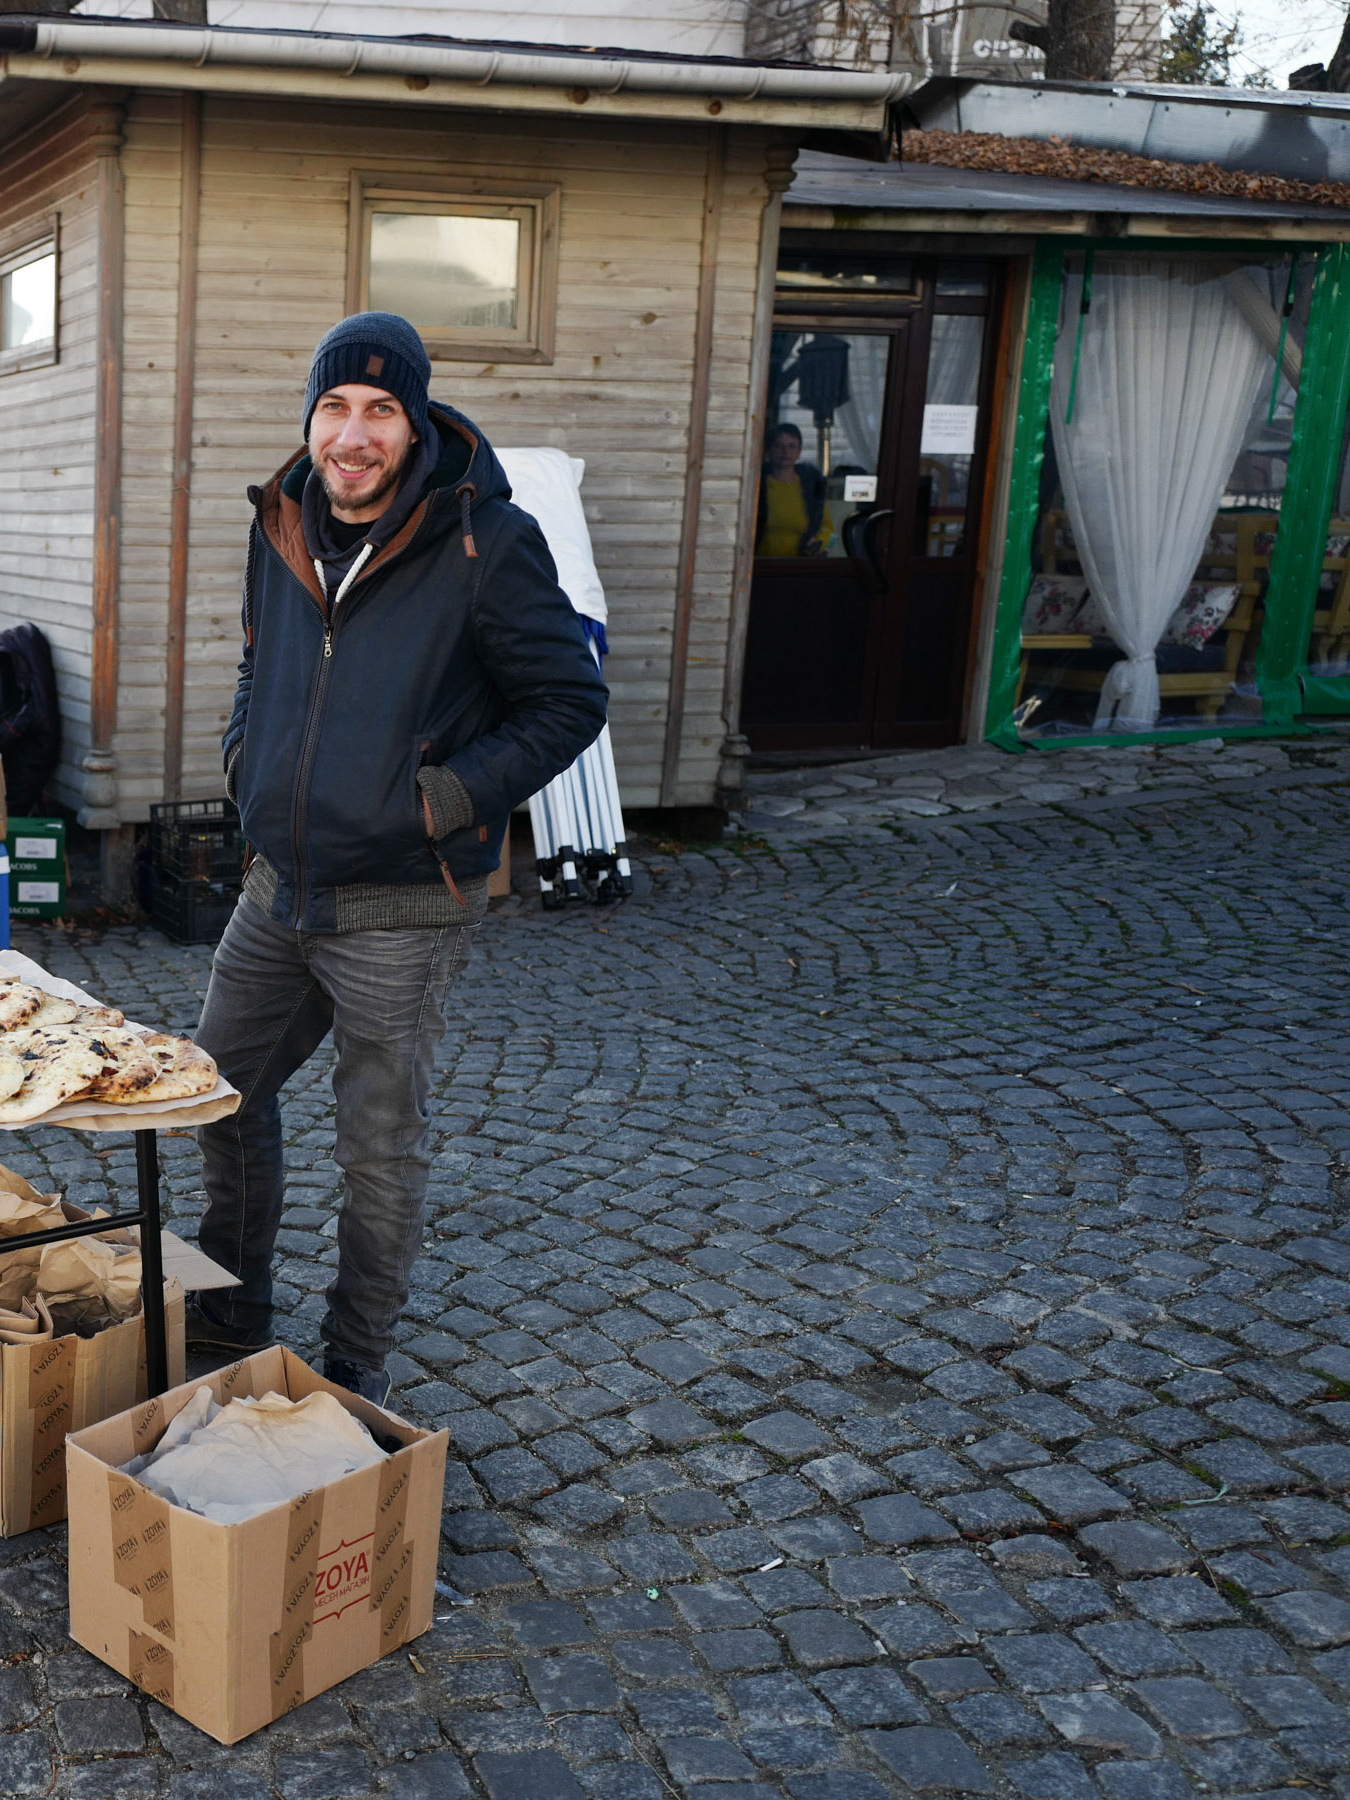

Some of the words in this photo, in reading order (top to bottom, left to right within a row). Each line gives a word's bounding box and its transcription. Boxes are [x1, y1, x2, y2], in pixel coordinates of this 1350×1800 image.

[9, 862, 38, 871] ACOBS
[38, 1347, 62, 1370] ZOYA
[41, 1406, 64, 1429] ZOYA
[140, 1401, 159, 1430] ZOYA
[39, 1448, 61, 1470] ZOYA
[36, 1488, 57, 1511] ZOYA
[115, 1488, 132, 1509] ZOYA
[384, 1480, 405, 1506] ZOYA
[144, 1521, 162, 1540] ZOYA
[294, 1527, 316, 1556] ZOYA
[380, 1527, 399, 1555] ZOYA
[118, 1538, 136, 1557] ZOYA
[147, 1570, 164, 1589] ZOYA
[314, 1551, 369, 1598] ZOYA
[290, 1578, 312, 1607] ZOYA
[376, 1575, 396, 1603] ZOYA
[387, 1602, 406, 1631] ZOYA
[278, 1648, 297, 1679] ZOYA
